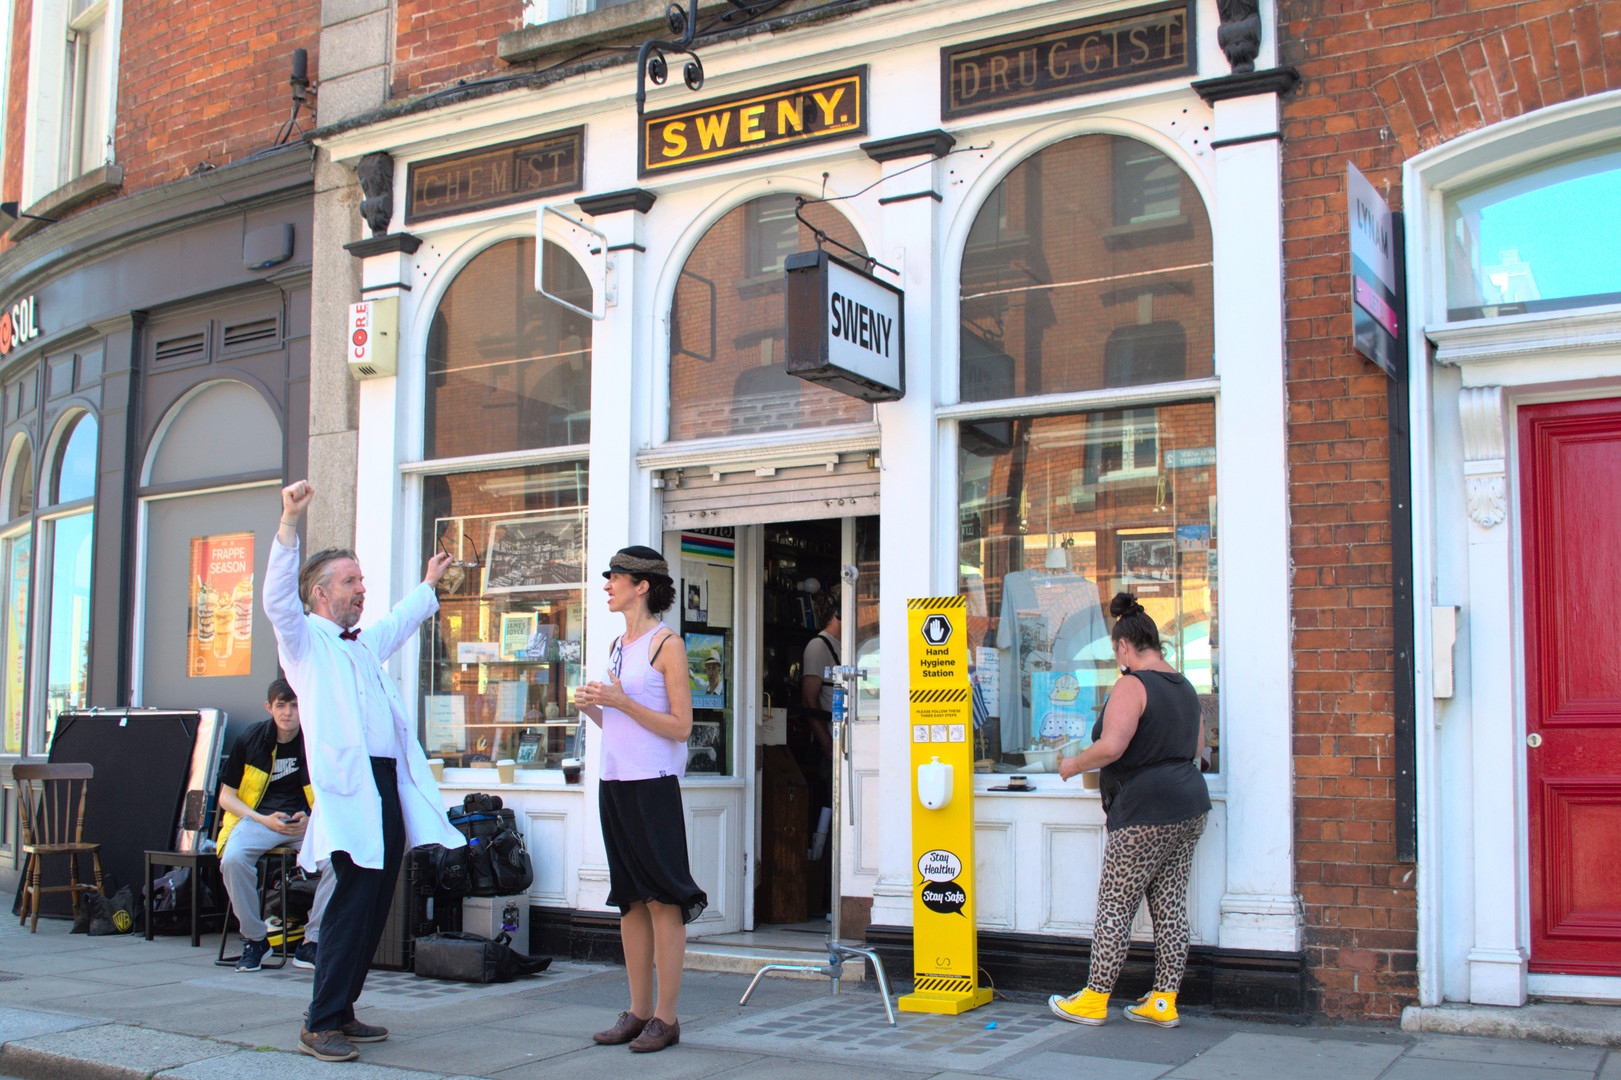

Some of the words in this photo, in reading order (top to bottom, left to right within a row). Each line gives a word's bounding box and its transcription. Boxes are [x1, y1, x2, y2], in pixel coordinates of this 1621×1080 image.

[960, 20, 1180, 100] DRUGGIST
[661, 87, 848, 157] SWENY.
[422, 150, 567, 206] CHEMIST
[1356, 198, 1389, 260] LYNAM
[11, 295, 38, 347] SOL
[352, 303, 368, 358] CORE
[831, 291, 892, 358] SWENY
[210, 561, 246, 574] SEASON
[212, 547, 245, 559] FRAPPE
[920, 659, 956, 668] Hygiene
[922, 669, 954, 677] Station
[924, 864, 956, 876] Healthy
[930, 852, 949, 864] Stay
[923, 890, 943, 904] Stay
[944, 890, 965, 904] Safe
